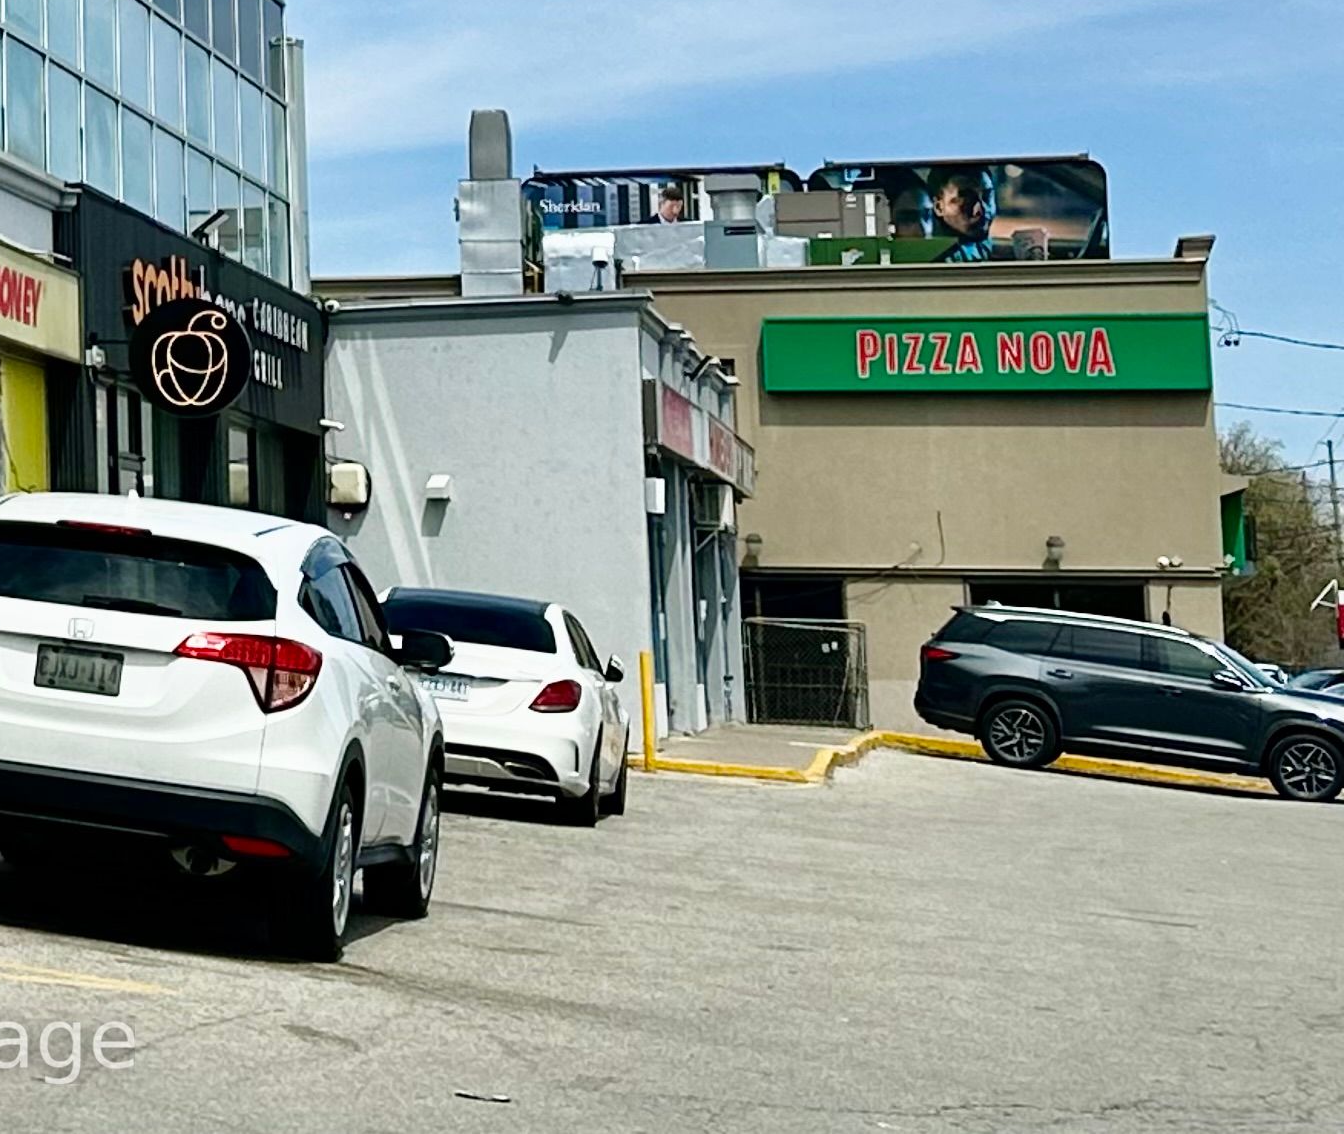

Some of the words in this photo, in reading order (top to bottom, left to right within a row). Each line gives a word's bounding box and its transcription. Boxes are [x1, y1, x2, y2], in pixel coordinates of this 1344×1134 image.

[540, 198, 600, 214] Sheridan
[254, 349, 283, 390] GRILL
[856, 329, 983, 378] PIZZA
[997, 327, 1116, 377] NOVA
